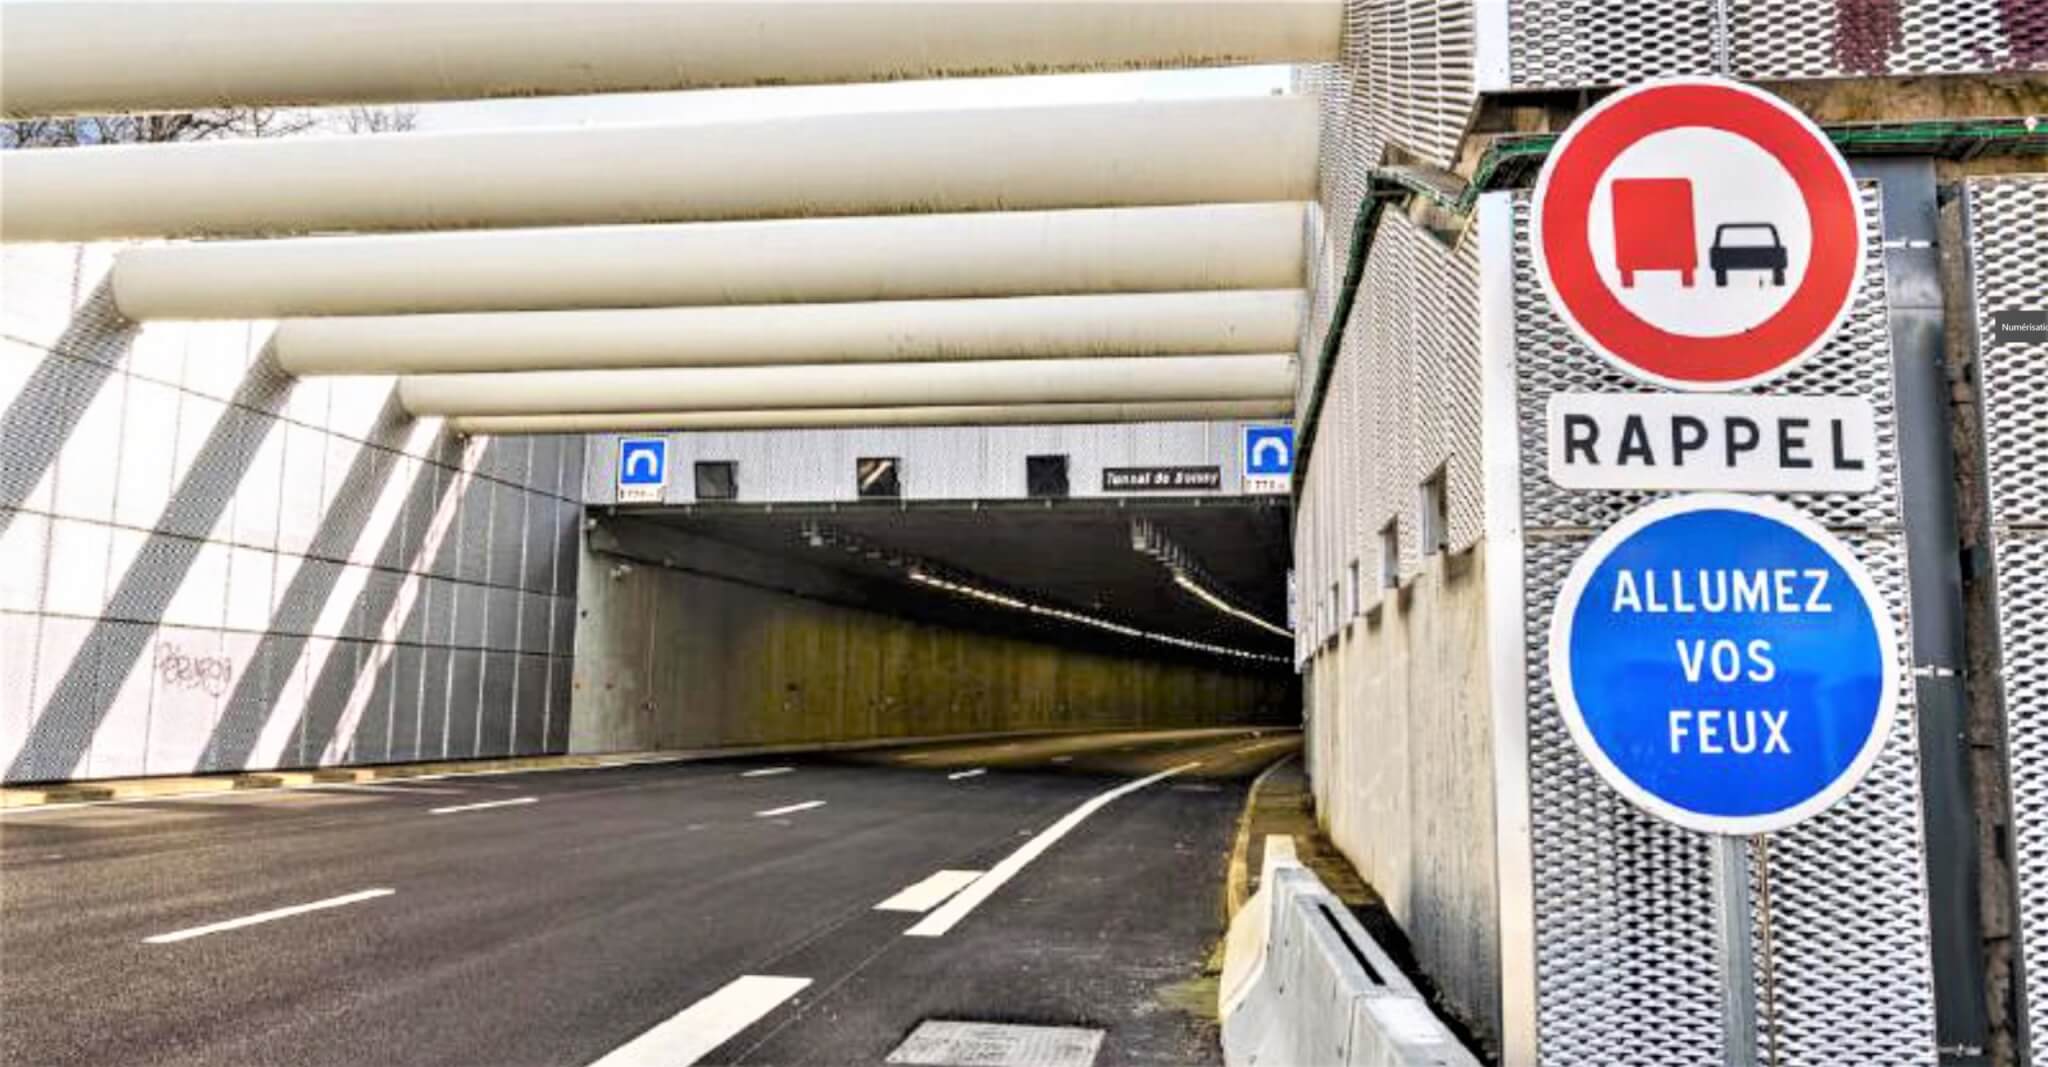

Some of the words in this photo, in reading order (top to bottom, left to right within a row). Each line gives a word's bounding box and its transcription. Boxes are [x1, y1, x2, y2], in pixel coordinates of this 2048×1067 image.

[1563, 413, 1865, 470] RAPPEL
[1107, 471, 1151, 485] Tunnel
[1154, 471, 1170, 484] de
[1612, 569, 1833, 613] ALLUMEZ
[1675, 638, 1777, 683] VOS
[1668, 710, 1791, 754] FEUX
